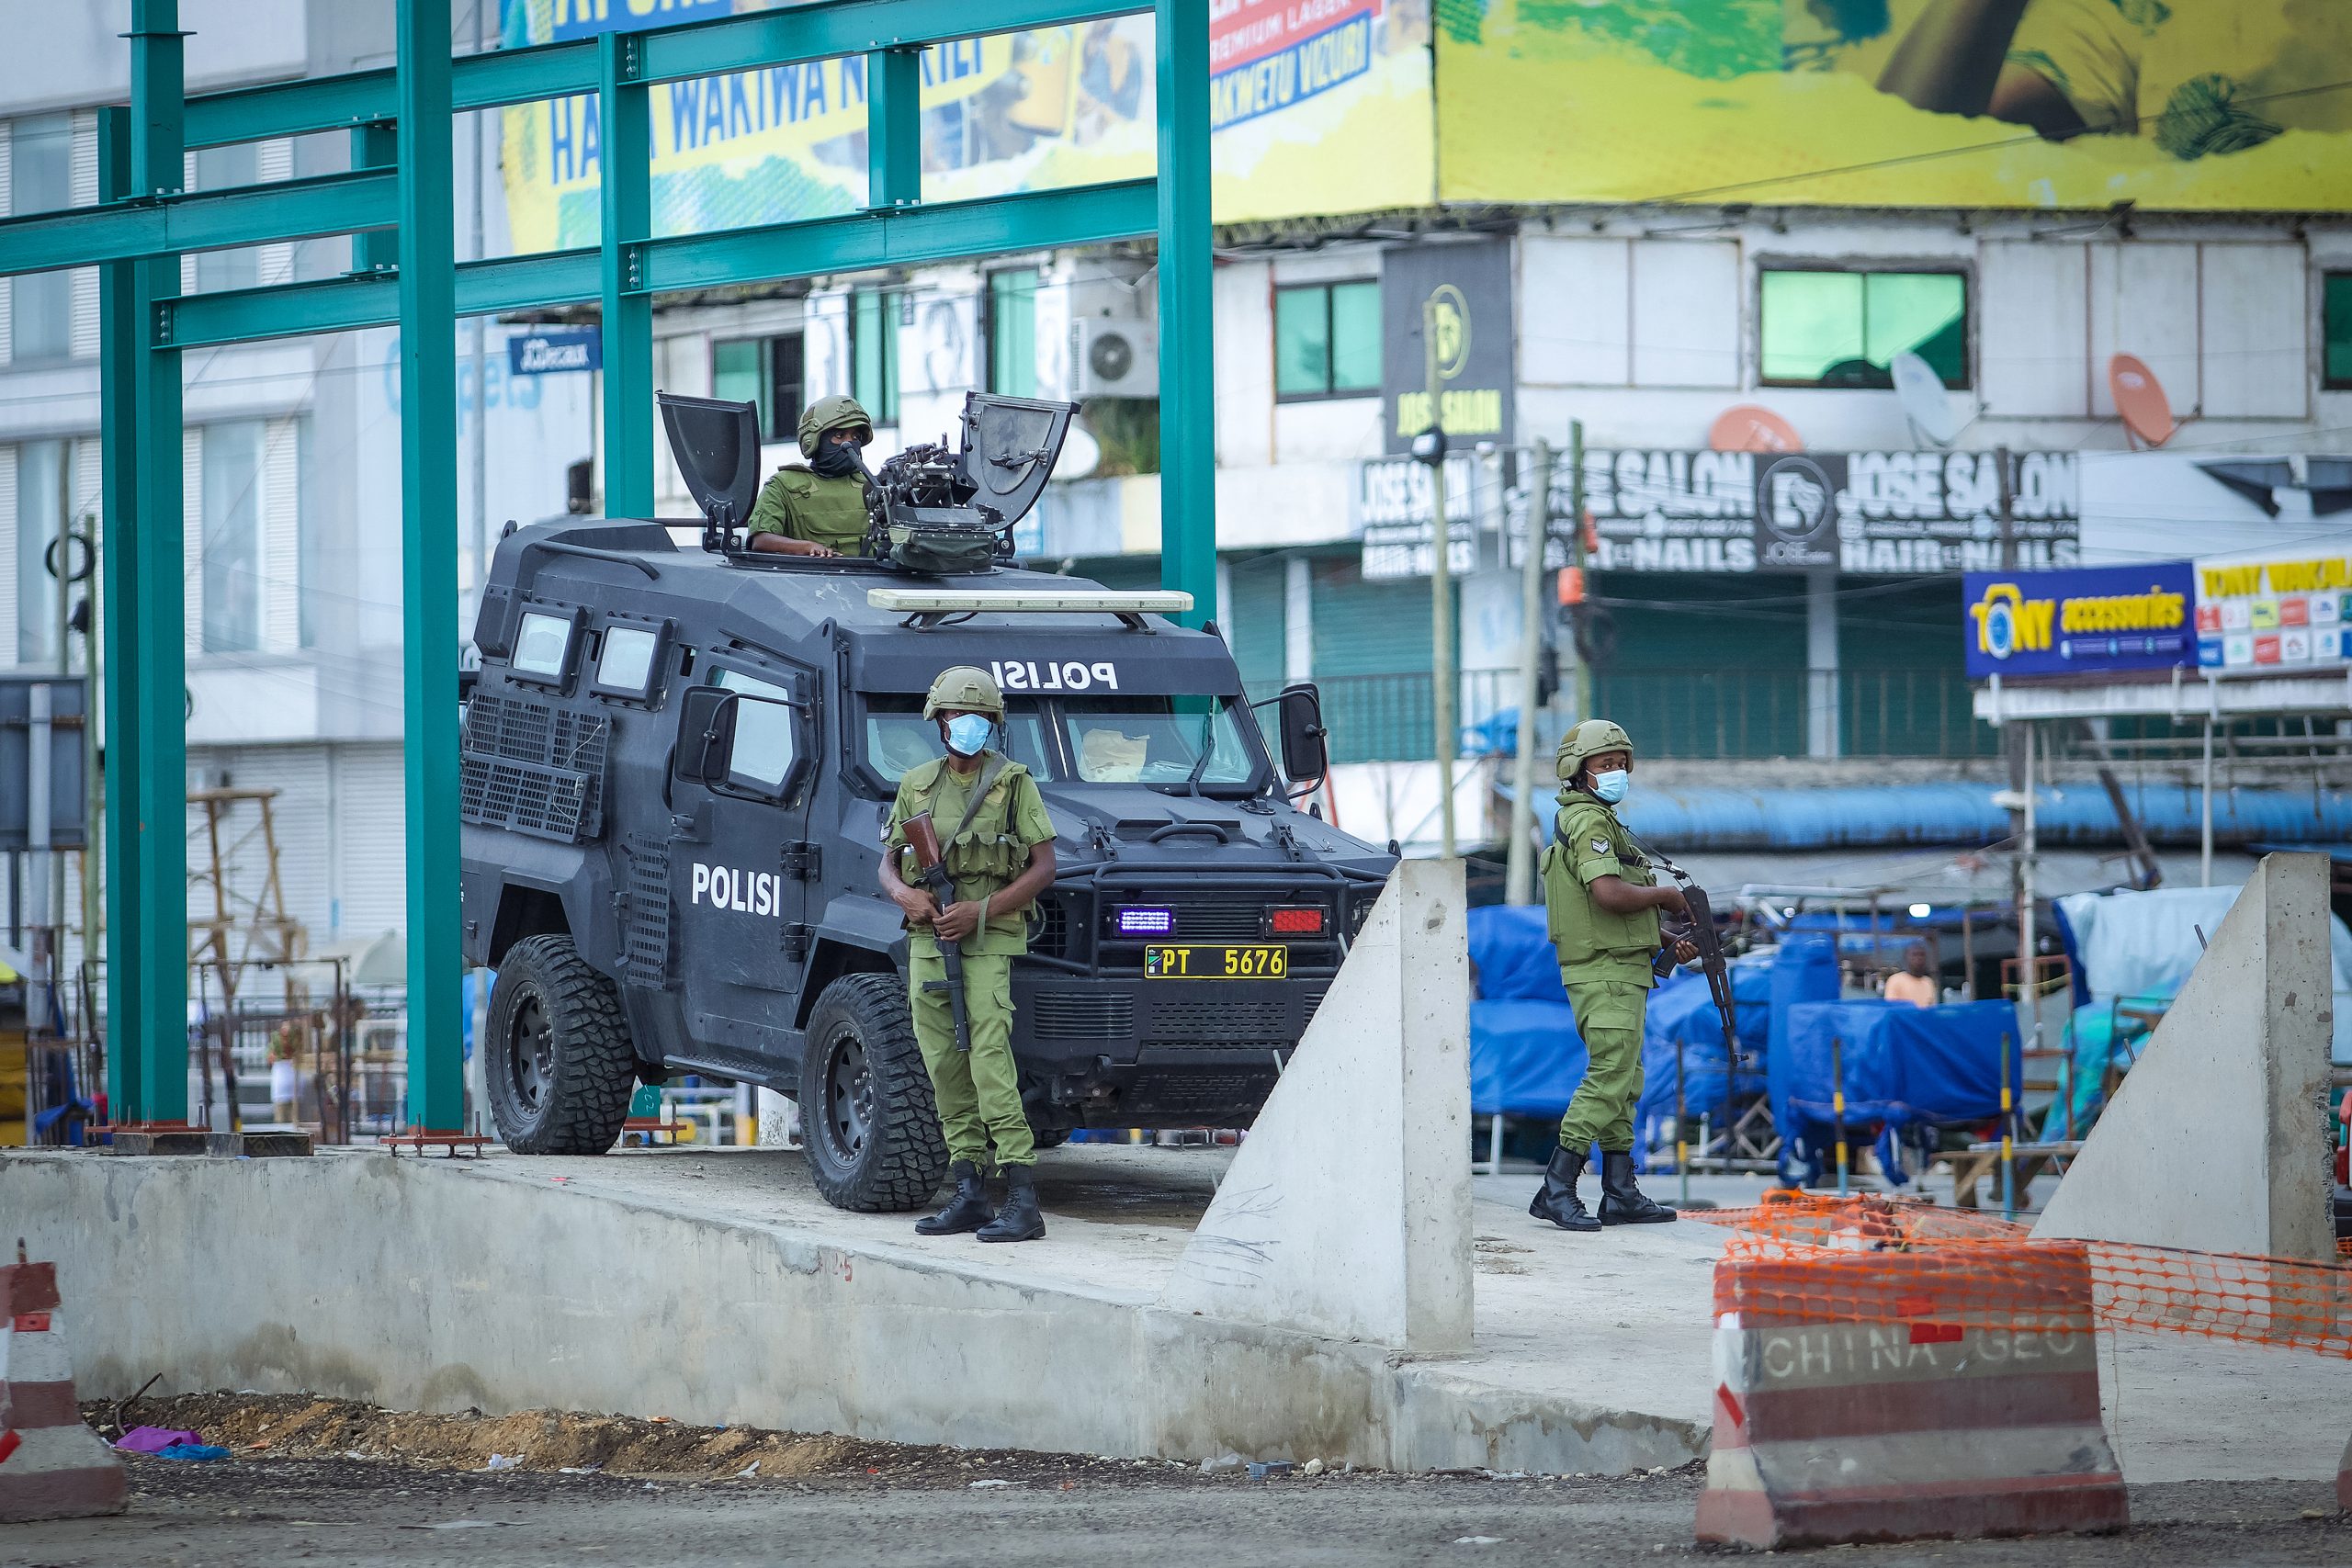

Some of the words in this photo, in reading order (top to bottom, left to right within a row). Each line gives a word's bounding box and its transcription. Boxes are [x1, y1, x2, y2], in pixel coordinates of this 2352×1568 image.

[1210, 13, 1283, 62] REMIUM
[670, 61, 827, 154] WAKIWA
[1614, 448, 1757, 518] SALON
[1836, 450, 1944, 519] JOSE
[1632, 537, 1758, 572] NAILS
[1839, 537, 1942, 573] HAIR
[2267, 558, 2352, 593] WAKAL
[692, 862, 781, 918] POLISI
[1162, 949, 1191, 975] PT
[1225, 949, 1283, 975] 5676
[1763, 1327, 1938, 1378] CHINA
[1975, 1314, 2078, 1361] GEO
